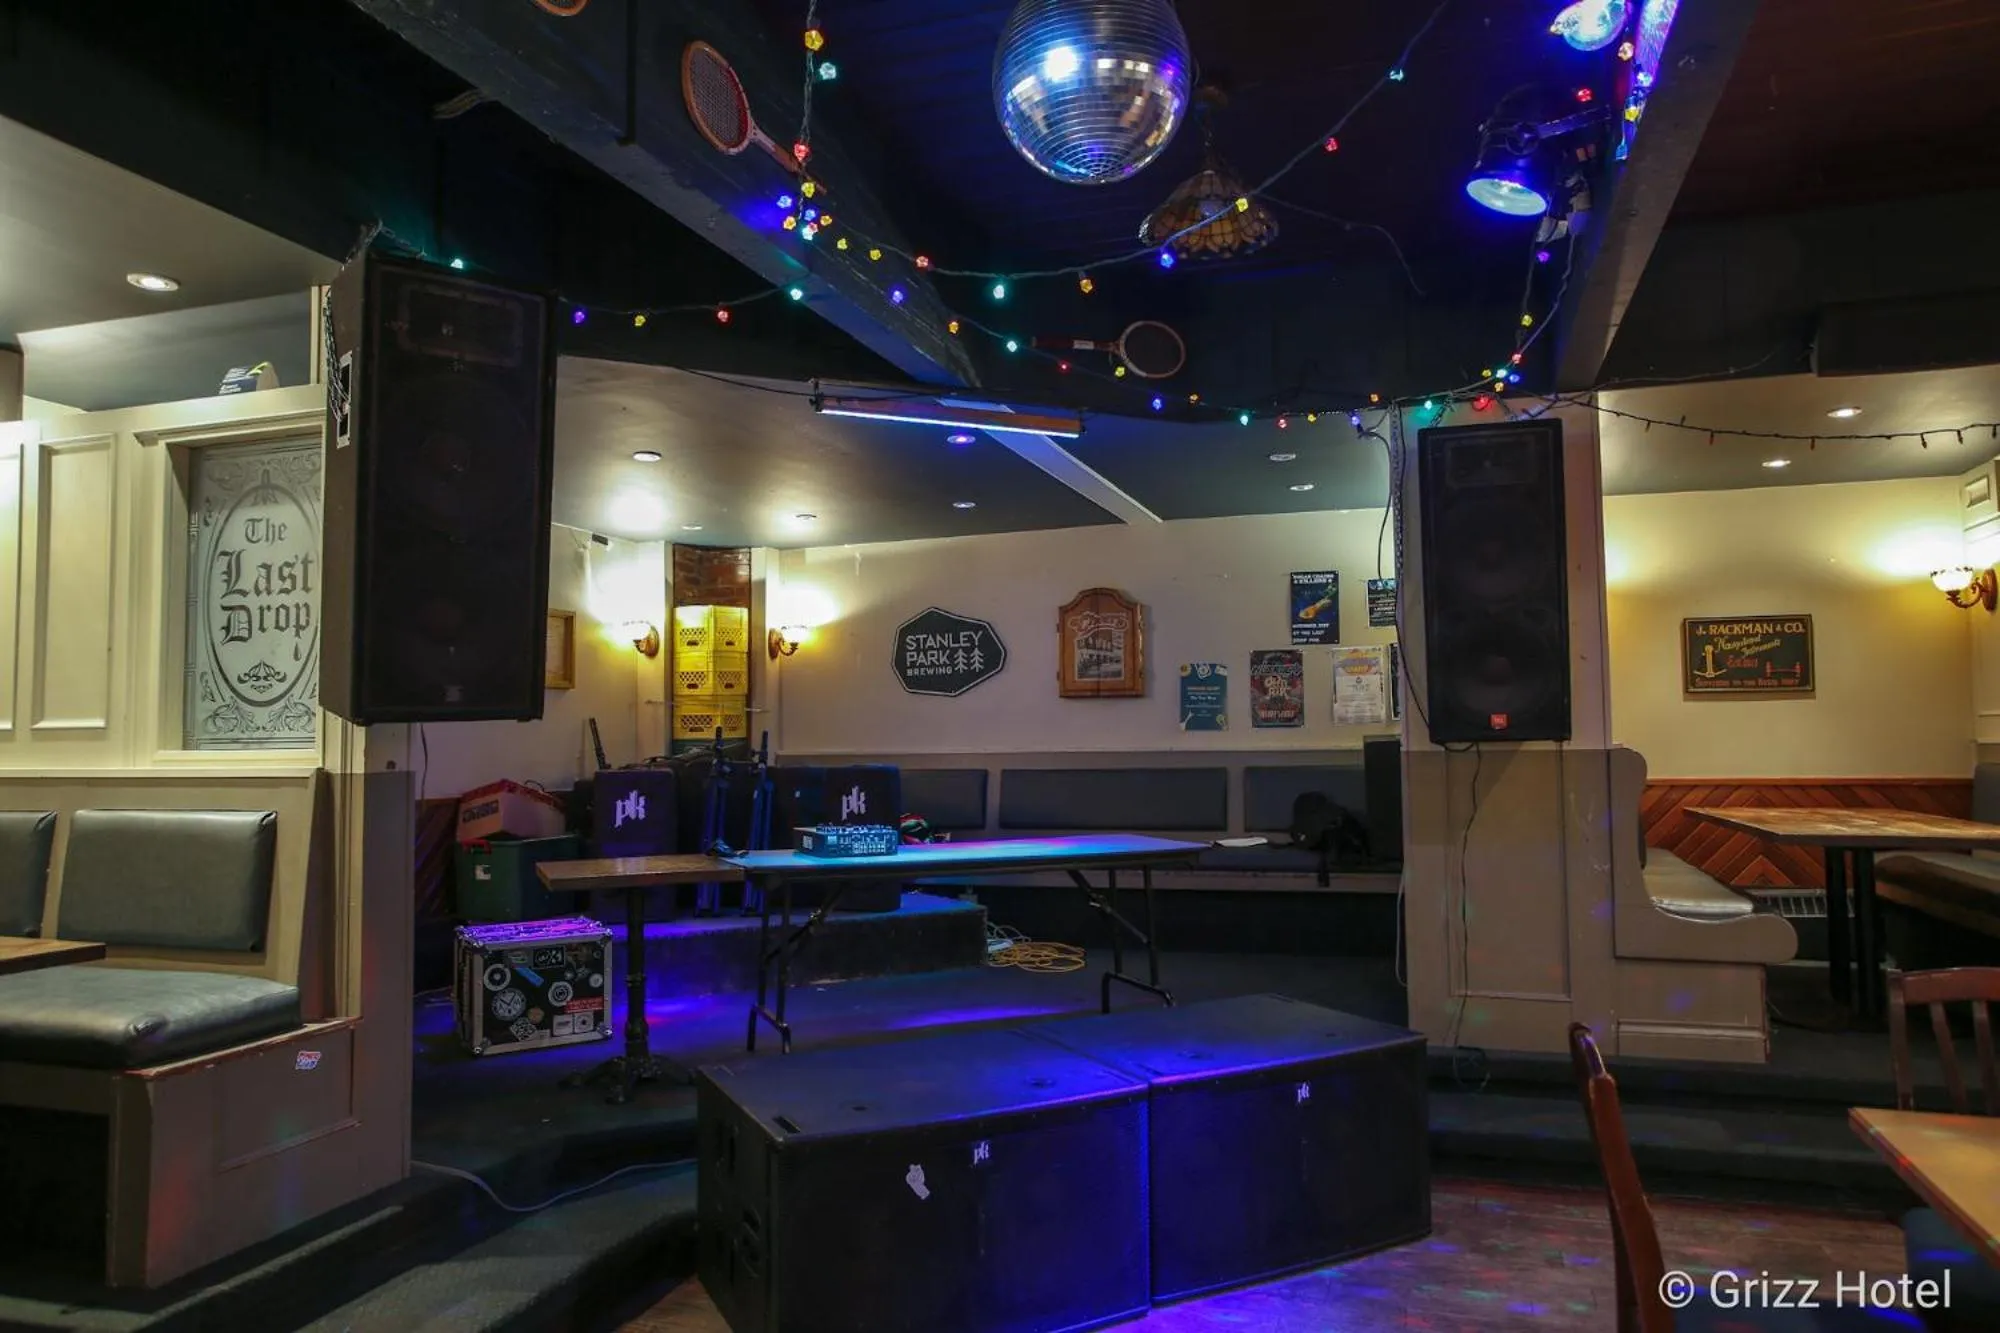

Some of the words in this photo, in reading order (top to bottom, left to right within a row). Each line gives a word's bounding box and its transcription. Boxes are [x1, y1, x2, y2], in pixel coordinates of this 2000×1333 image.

[244, 517, 288, 546] The
[217, 549, 314, 599] Last
[220, 601, 311, 646] Drop
[1709, 623, 1773, 635] RACKMAN
[906, 631, 982, 650] STANLEY
[906, 650, 950, 666] PARK
[907, 666, 953, 677] BREWING
